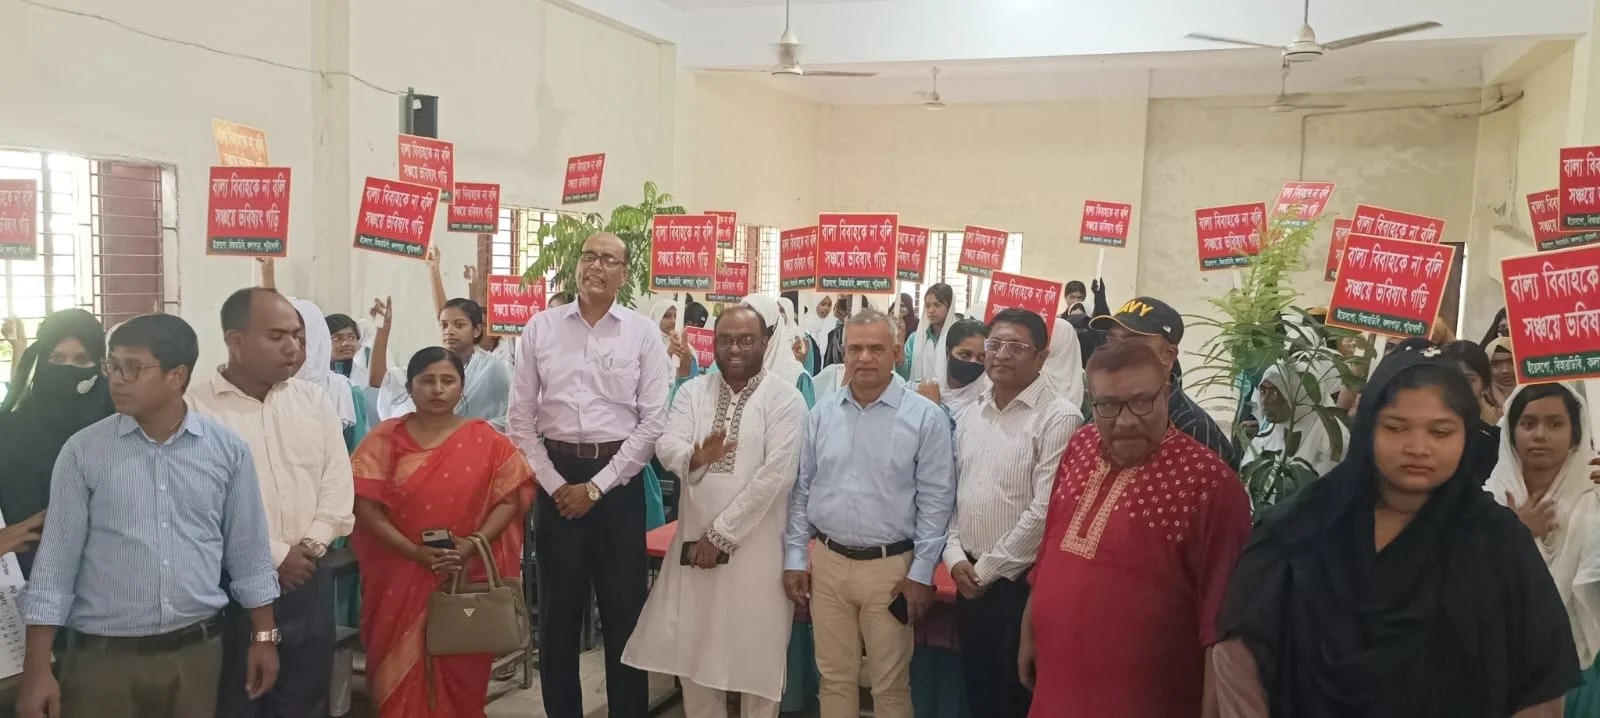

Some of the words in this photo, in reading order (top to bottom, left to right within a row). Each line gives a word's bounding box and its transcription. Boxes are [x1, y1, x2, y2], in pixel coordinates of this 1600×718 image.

[1563, 159, 1584, 178] বাল্য
[212, 178, 228, 198] বাল্য
[231, 172, 259, 198] বিবাহকে
[262, 179, 270, 198] না
[272, 172, 286, 198] বলি
[366, 187, 381, 204] বাল্য
[383, 184, 410, 207] বিবাহকে
[411, 195, 419, 210] না
[421, 192, 433, 212] বলি
[1568, 187, 1594, 205] সঞ্চয়ে
[215, 208, 236, 228] সঞ্চয়ে
[238, 203, 263, 228] ভবিষ্যৎ
[266, 203, 280, 232] গড়ি
[365, 212, 385, 229] সঞ্চয়ে
[386, 211, 409, 233] ভবিষ্যৎ
[411, 216, 425, 239] গড়ি
[822, 224, 837, 242] বাল্য
[839, 219, 868, 242] বিবাহকে
[870, 224, 877, 242] না
[880, 219, 892, 242] বলি
[1357, 216, 1374, 233] বাল্য
[1375, 213, 1408, 239] বিবাহকে
[1409, 225, 1419, 240] না
[1421, 223, 1436, 244] বলি
[656, 226, 668, 241] বাল্য
[670, 220, 692, 242] বিবাহকে
[694, 226, 701, 242] না
[702, 220, 713, 241] বলি
[658, 252, 674, 267] সঞ্চয়ে
[676, 246, 695, 268] ভবিষ্যৎ
[698, 246, 708, 272] গড়ি
[825, 251, 844, 268] সঞ্চয়ে
[847, 246, 871, 268] ভবিষ্যৎ
[874, 246, 887, 271] গড়ি
[1348, 247, 1369, 268] বাল্য
[1370, 243, 1409, 274] বিবাহকে
[1411, 256, 1424, 277] না
[1425, 252, 1444, 279] বলি
[993, 281, 1007, 296] বাল্য
[1008, 279, 1034, 300] বিবাহকে
[1035, 288, 1043, 304] না
[1044, 286, 1057, 304] বলি
[1508, 273, 1539, 304] বাল্য
[1542, 261, 1599, 299] বিবাহকে
[1119, 300, 1154, 317] AVY
[1345, 278, 1374, 302] সঞ্চয়ে
[1376, 278, 1407, 308] ভবিষ্যৎ
[1410, 283, 1429, 314] গড়ি
[1522, 314, 1561, 343] সঞ্চয়ে
[1564, 302, 1600, 338] ভবিষ
